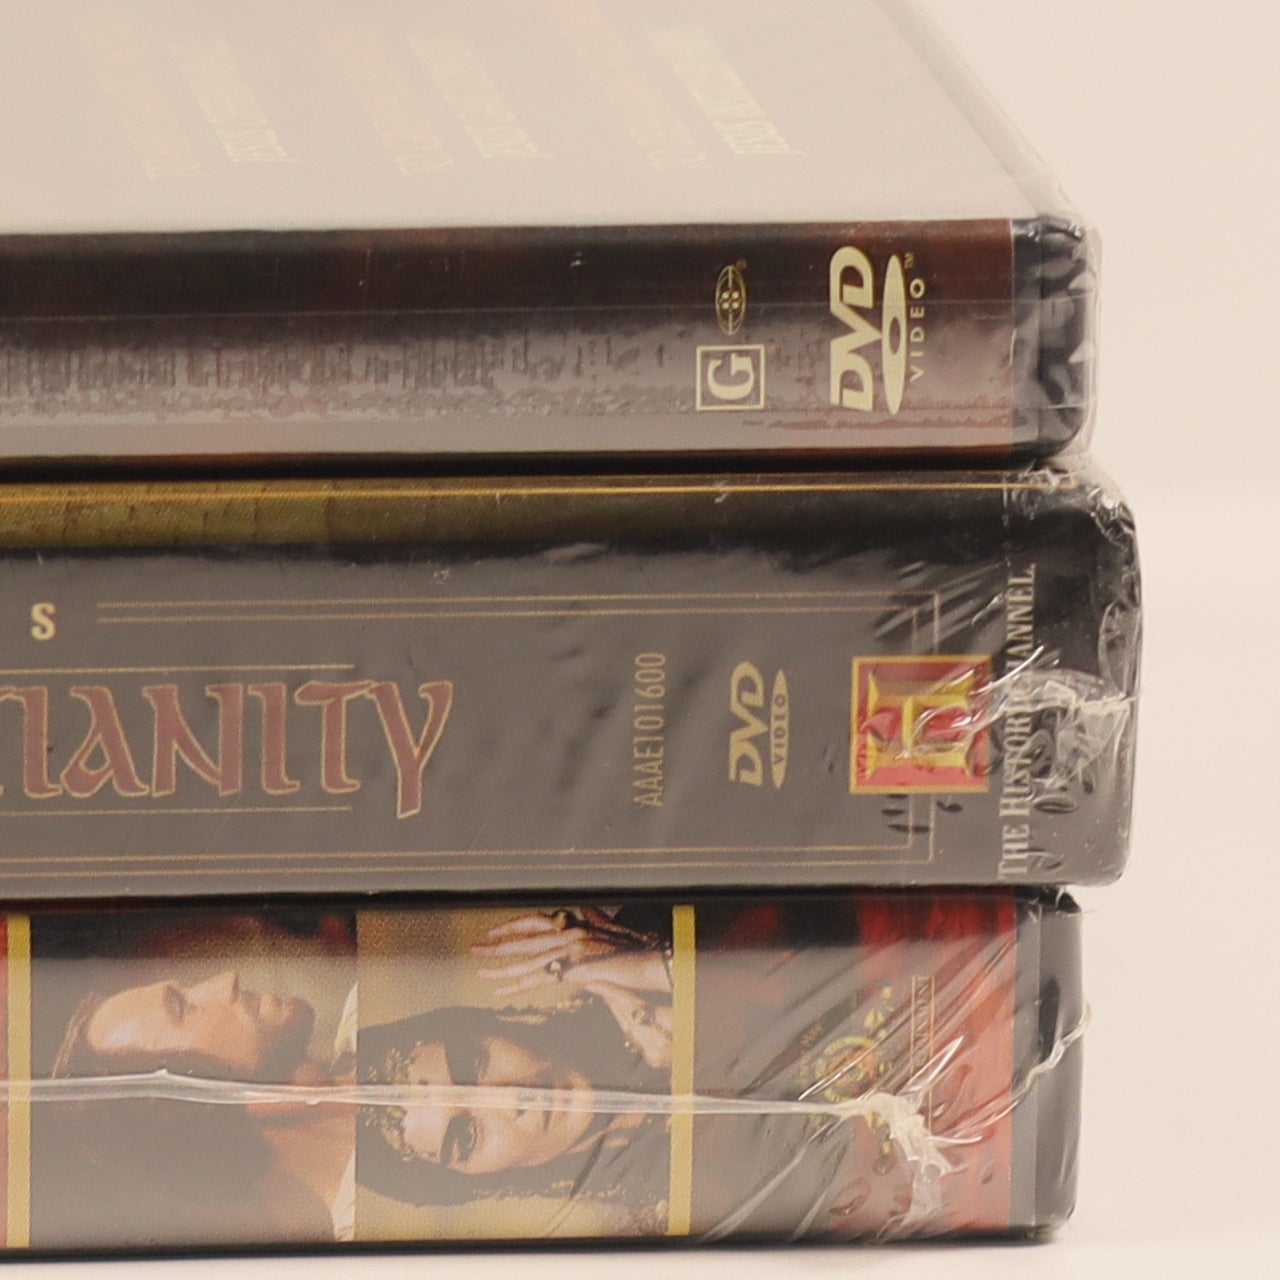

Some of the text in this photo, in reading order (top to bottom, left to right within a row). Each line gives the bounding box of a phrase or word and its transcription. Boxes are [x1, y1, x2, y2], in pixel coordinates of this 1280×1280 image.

[706, 351, 755, 401] G
[829, 245, 883, 412] DVD
[909, 277, 926, 382] VIDEO
[633, 651, 667, 808] AAAE101600
[728, 660, 770, 787] DVD
[771, 693, 788, 765] VIDEO
[997, 823, 1030, 880] THE
